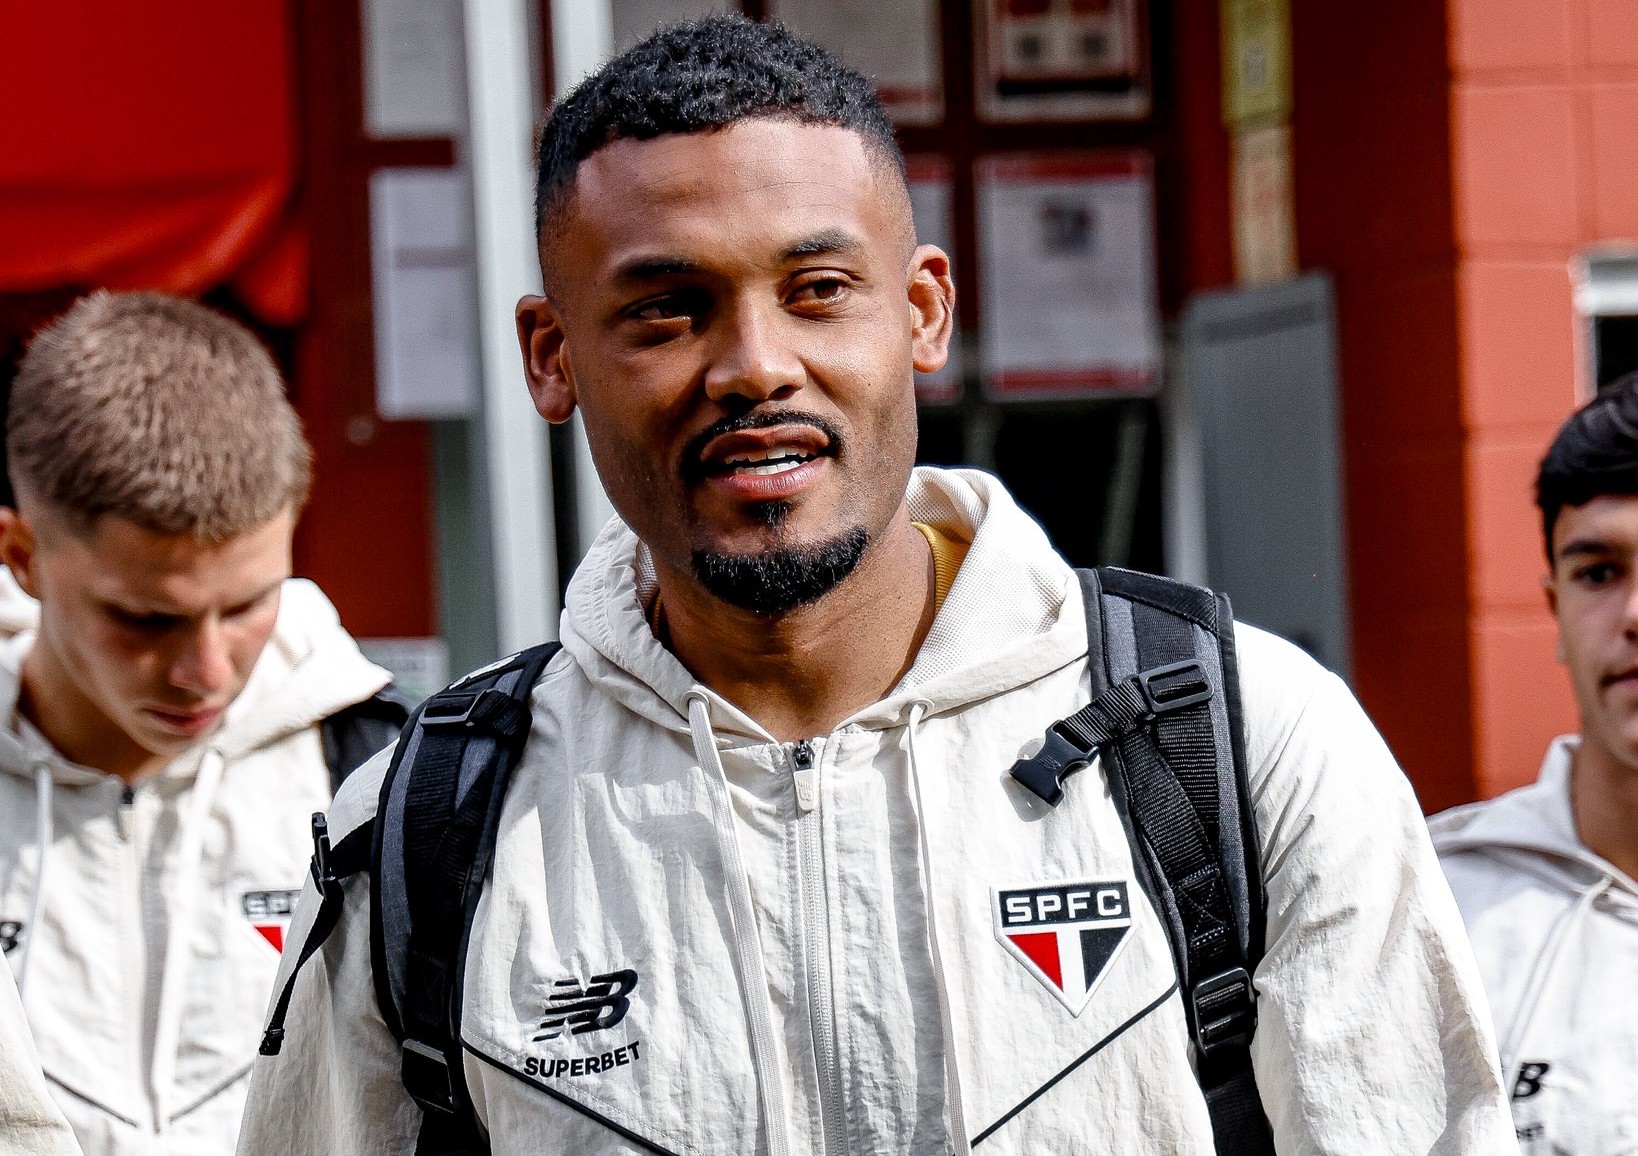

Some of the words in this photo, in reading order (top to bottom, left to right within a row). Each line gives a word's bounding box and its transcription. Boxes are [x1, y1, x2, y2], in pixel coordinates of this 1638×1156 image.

[1005, 889, 1122, 923] SPFC
[523, 1040, 640, 1078] SUPERBET
[1511, 1062, 1549, 1101] B
